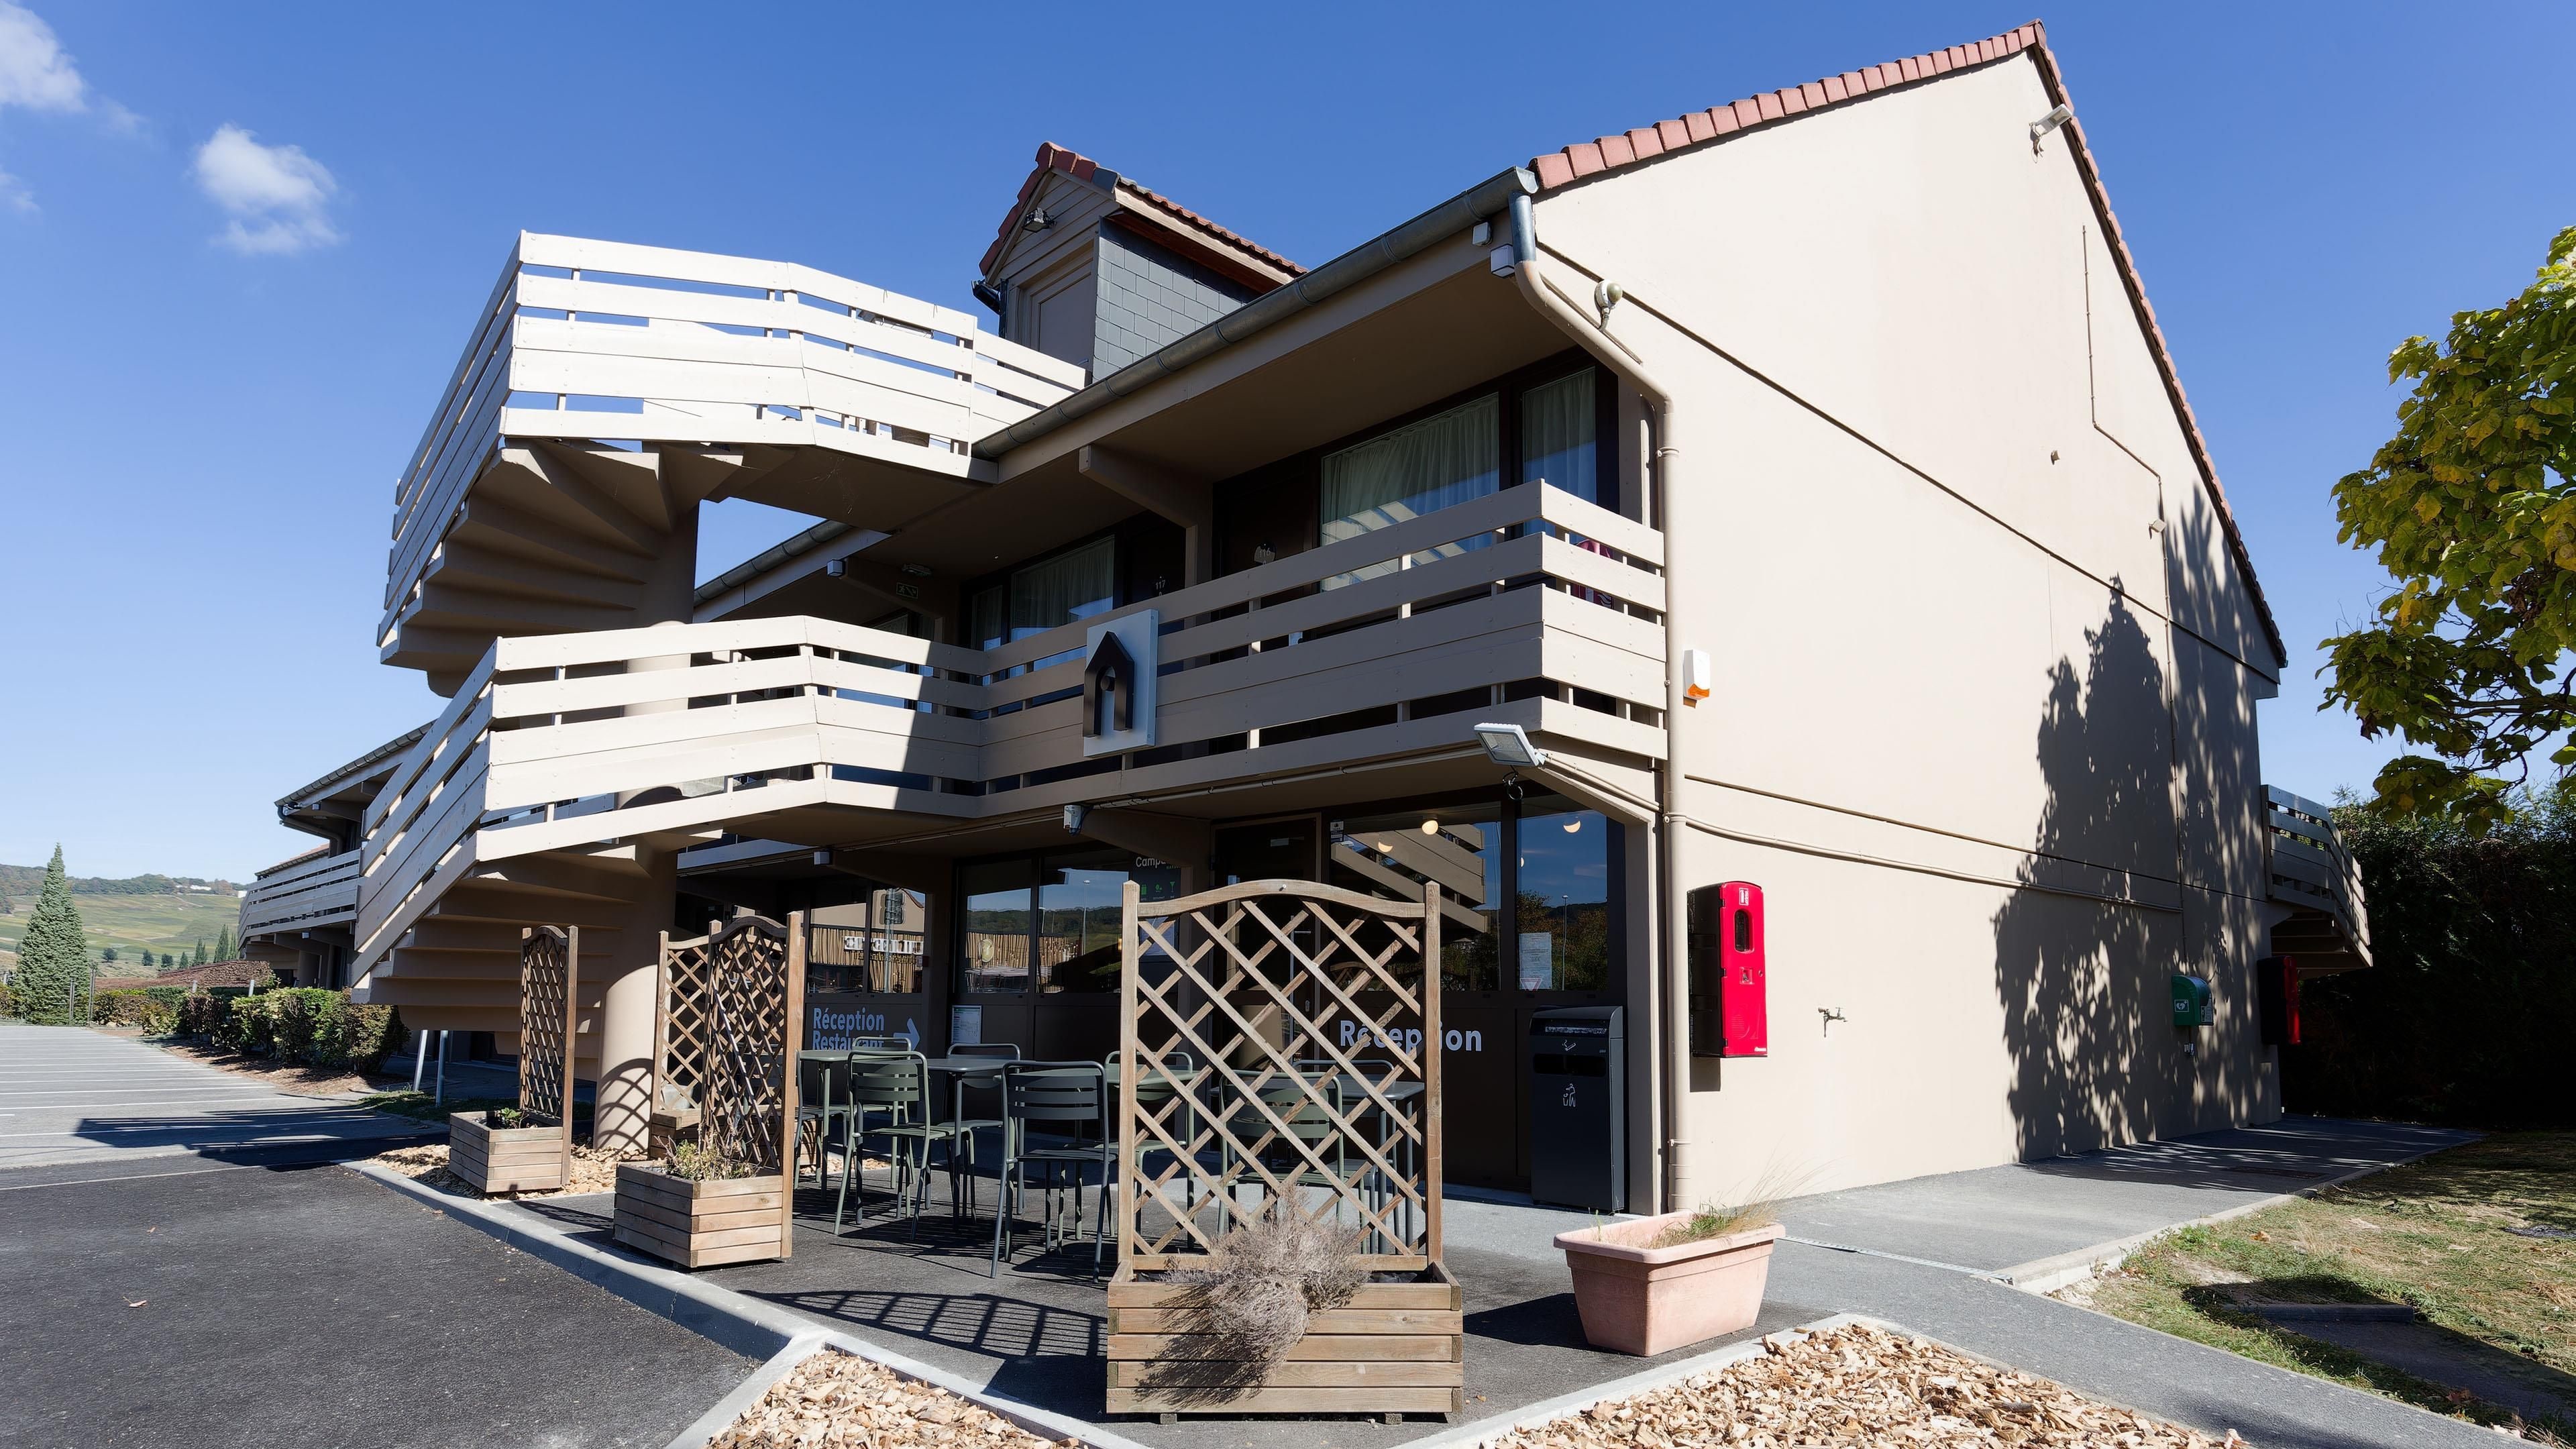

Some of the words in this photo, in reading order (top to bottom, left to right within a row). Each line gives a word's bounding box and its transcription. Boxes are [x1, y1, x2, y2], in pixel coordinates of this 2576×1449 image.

[1259, 547, 1271, 559] 116
[1155, 580, 1166, 590] 117
[813, 1007, 885, 1037] Réception
[1340, 1020, 1482, 1056] Récepion
